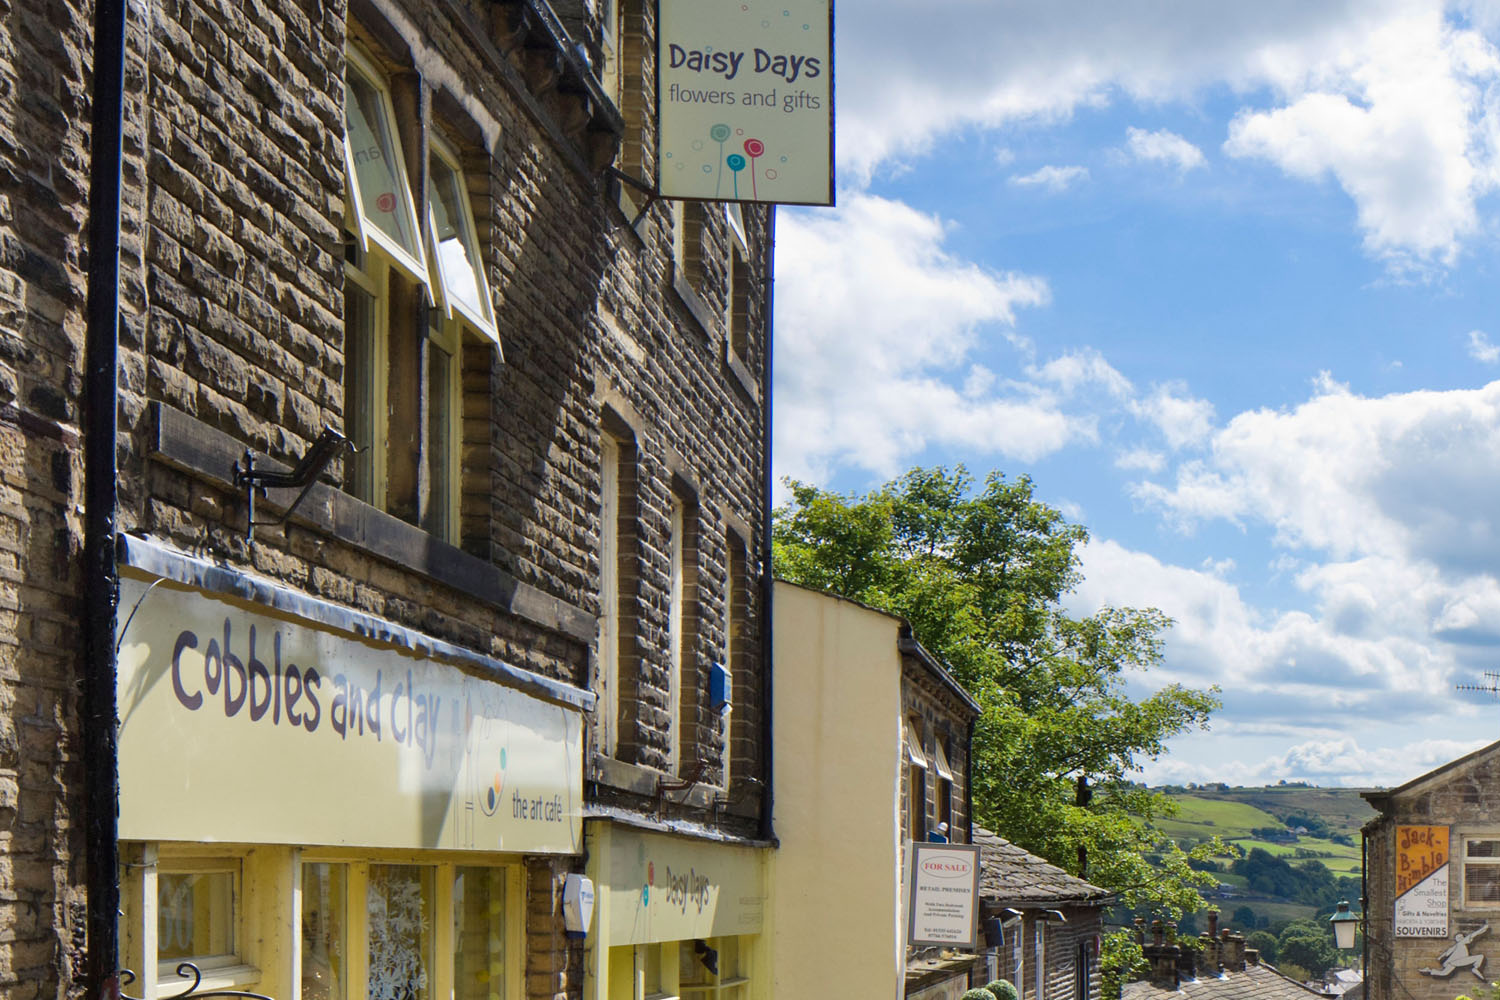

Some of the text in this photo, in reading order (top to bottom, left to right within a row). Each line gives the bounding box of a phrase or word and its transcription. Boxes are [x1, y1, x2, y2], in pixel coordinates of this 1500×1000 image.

[669, 44, 821, 83] Daisy Days
[669, 84, 821, 113] flowers and gifts
[330, 668, 382, 741] and
[513, 788, 562, 822] the art café
[924, 862, 968, 872] FOR SALE
[666, 866, 710, 915] Daisy Days
[1433, 878, 1447, 886] The
[1413, 889, 1447, 897] Smallest
[1427, 899, 1447, 907] Shop
[1396, 926, 1447, 936] SOUVENIRS
